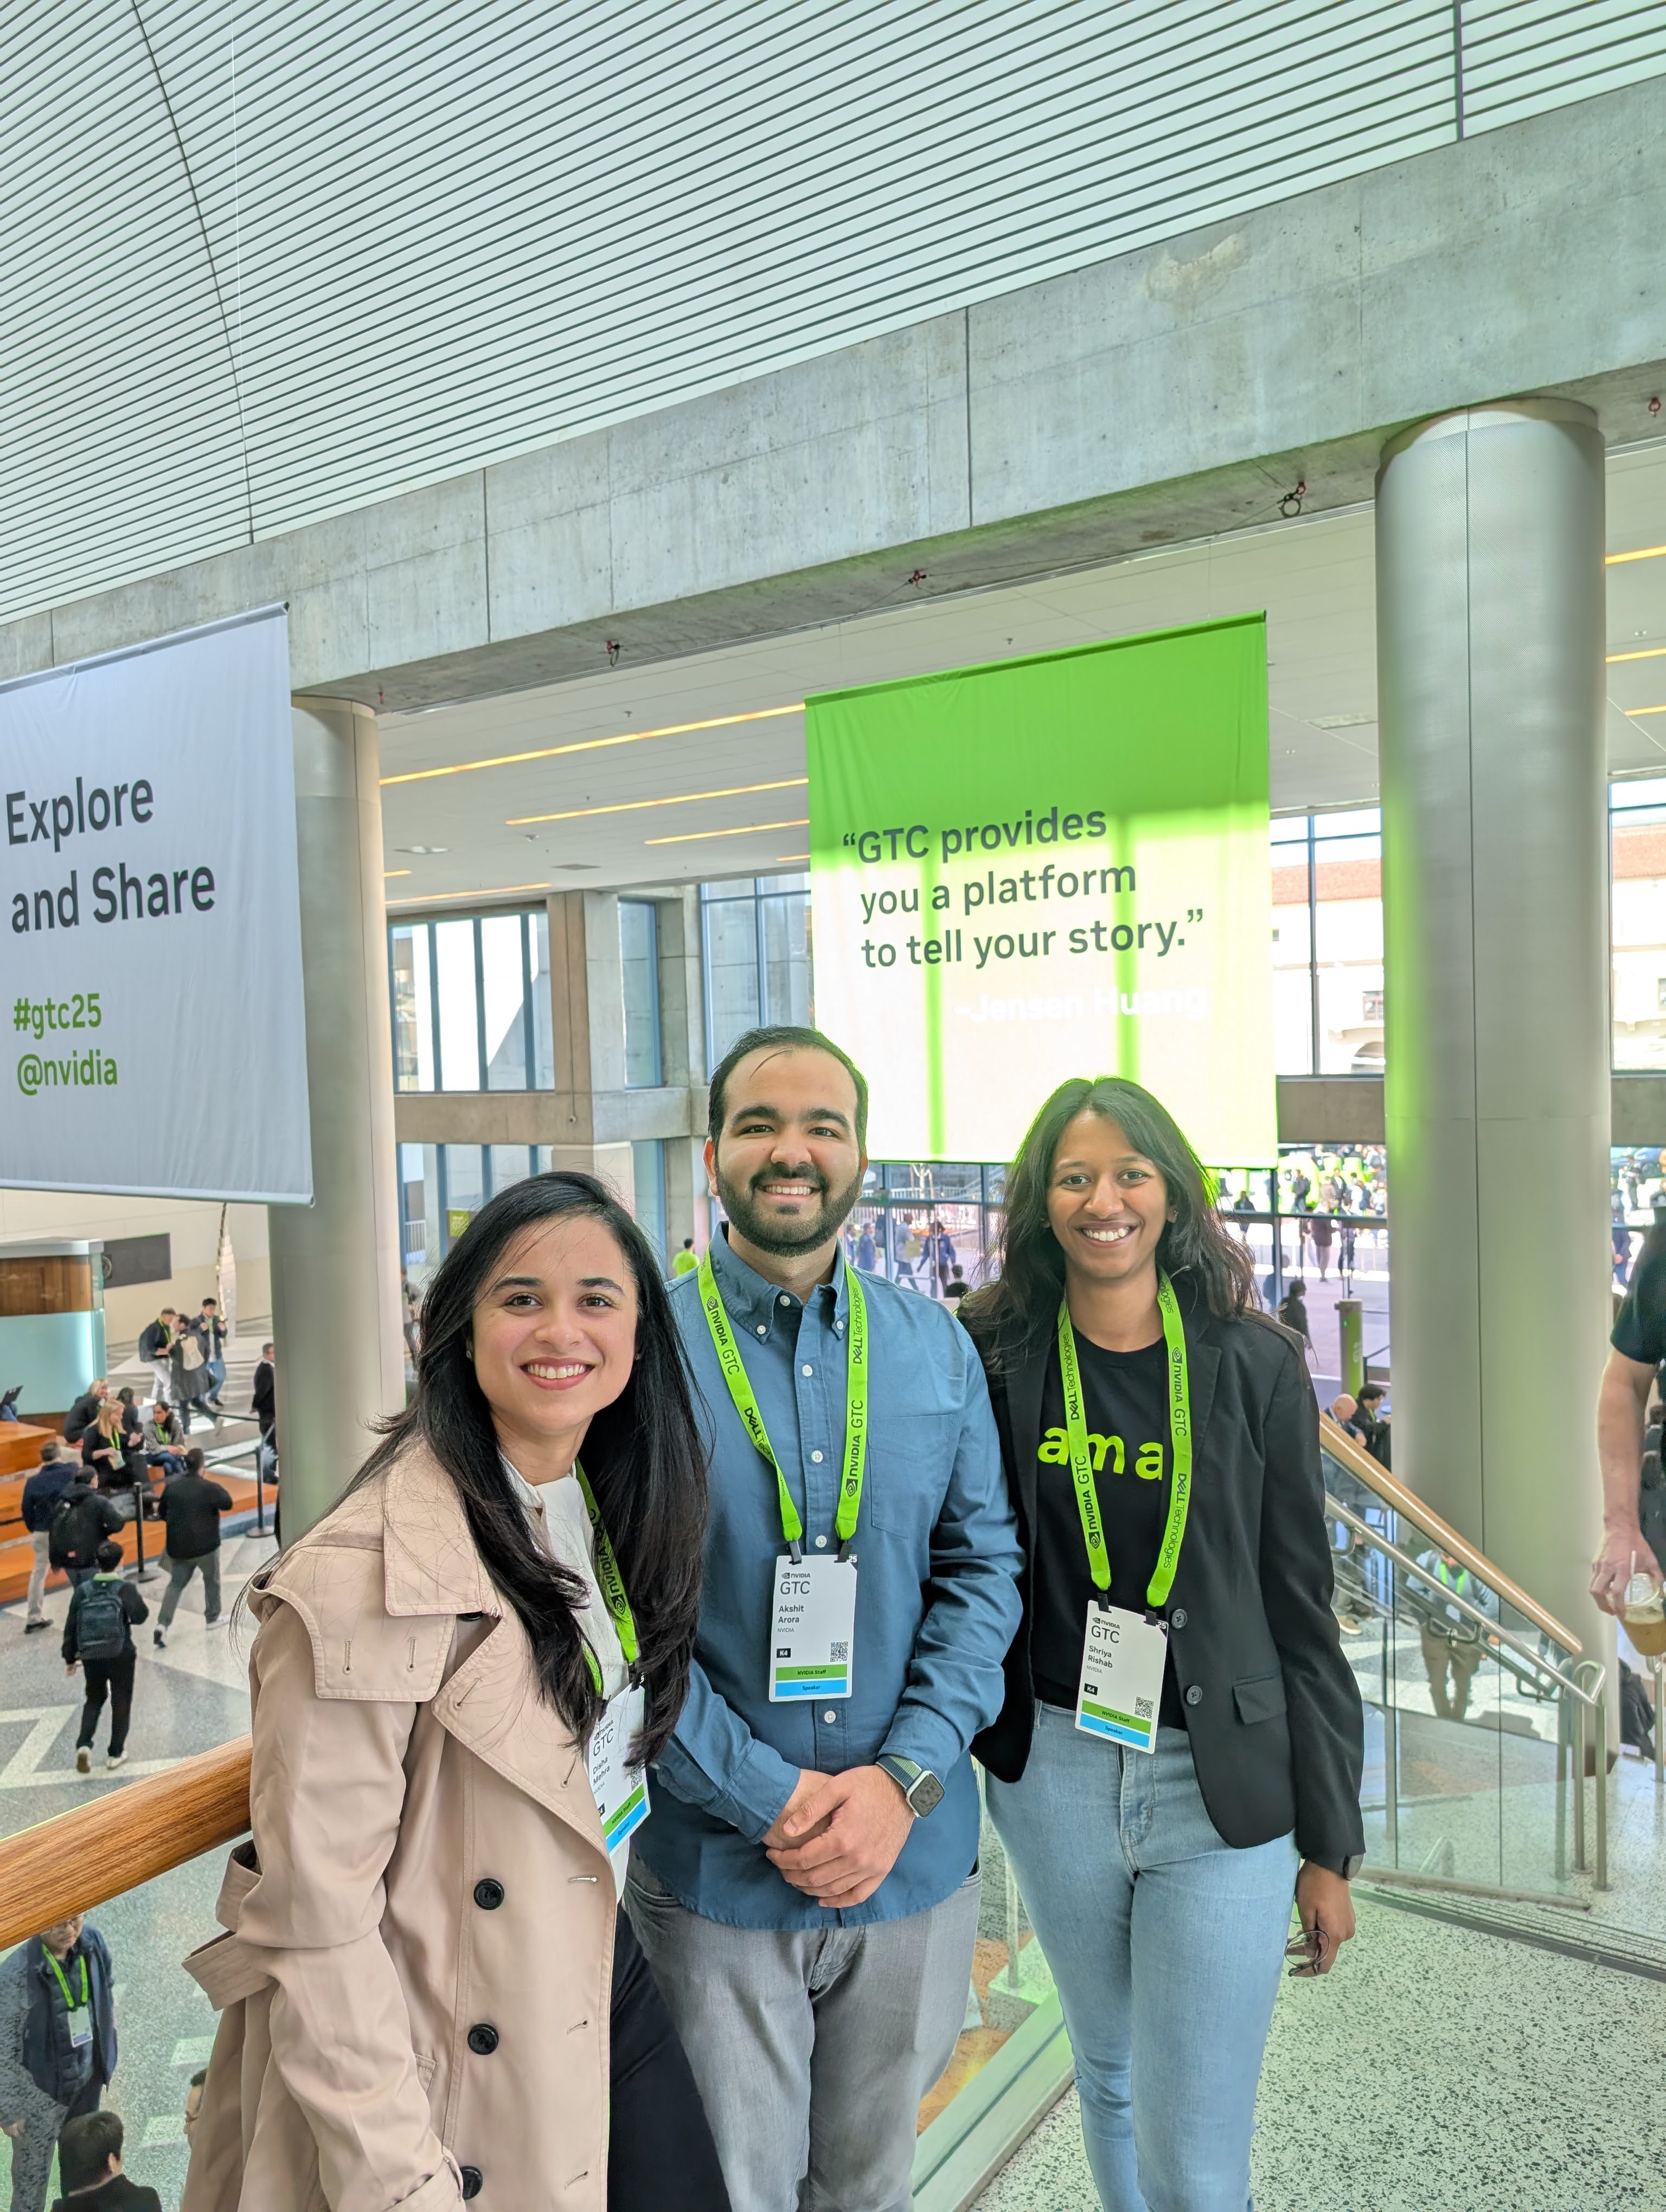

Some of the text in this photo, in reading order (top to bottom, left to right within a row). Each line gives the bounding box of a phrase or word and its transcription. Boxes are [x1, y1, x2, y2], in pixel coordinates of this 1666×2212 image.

[7, 776, 153, 852] Explore
[941, 807, 1107, 863] provides
[12, 863, 215, 934] and Share
[861, 864, 1136, 924] you a platform
[861, 937, 896, 968] to
[907, 930, 962, 964] tell
[974, 930, 1056, 969] your
[14, 993, 102, 1040] #gtc25
[1093, 987, 1208, 1021] Huang
[17, 1049, 118, 1095] @nvidia
[852, 1287, 863, 1336] Technologies
[722, 1349, 740, 1375] GTC
[1062, 1333, 1076, 1391] Technologies
[851, 1400, 863, 1428] GTC
[1174, 1409, 1187, 1437] GTC
[1074, 1455, 1090, 1484] GTC
[1163, 1504, 1184, 1568] Technologies
[780, 1581, 810, 1594] GTC
[1091, 1625, 1119, 1643] GTC
[1088, 1645, 1112, 1658] Shriya
[1088, 1655, 1113, 1668] Rishab
[1086, 1665, 1103, 1674] NVIDIA
[1101, 1710, 1118, 1720] NVIDIA
[593, 1728, 614, 1757] GTC
[1105, 1725, 1123, 1735] Speaker
[593, 1757, 608, 1775] Disha
[593, 1766, 610, 1786] Mehra
